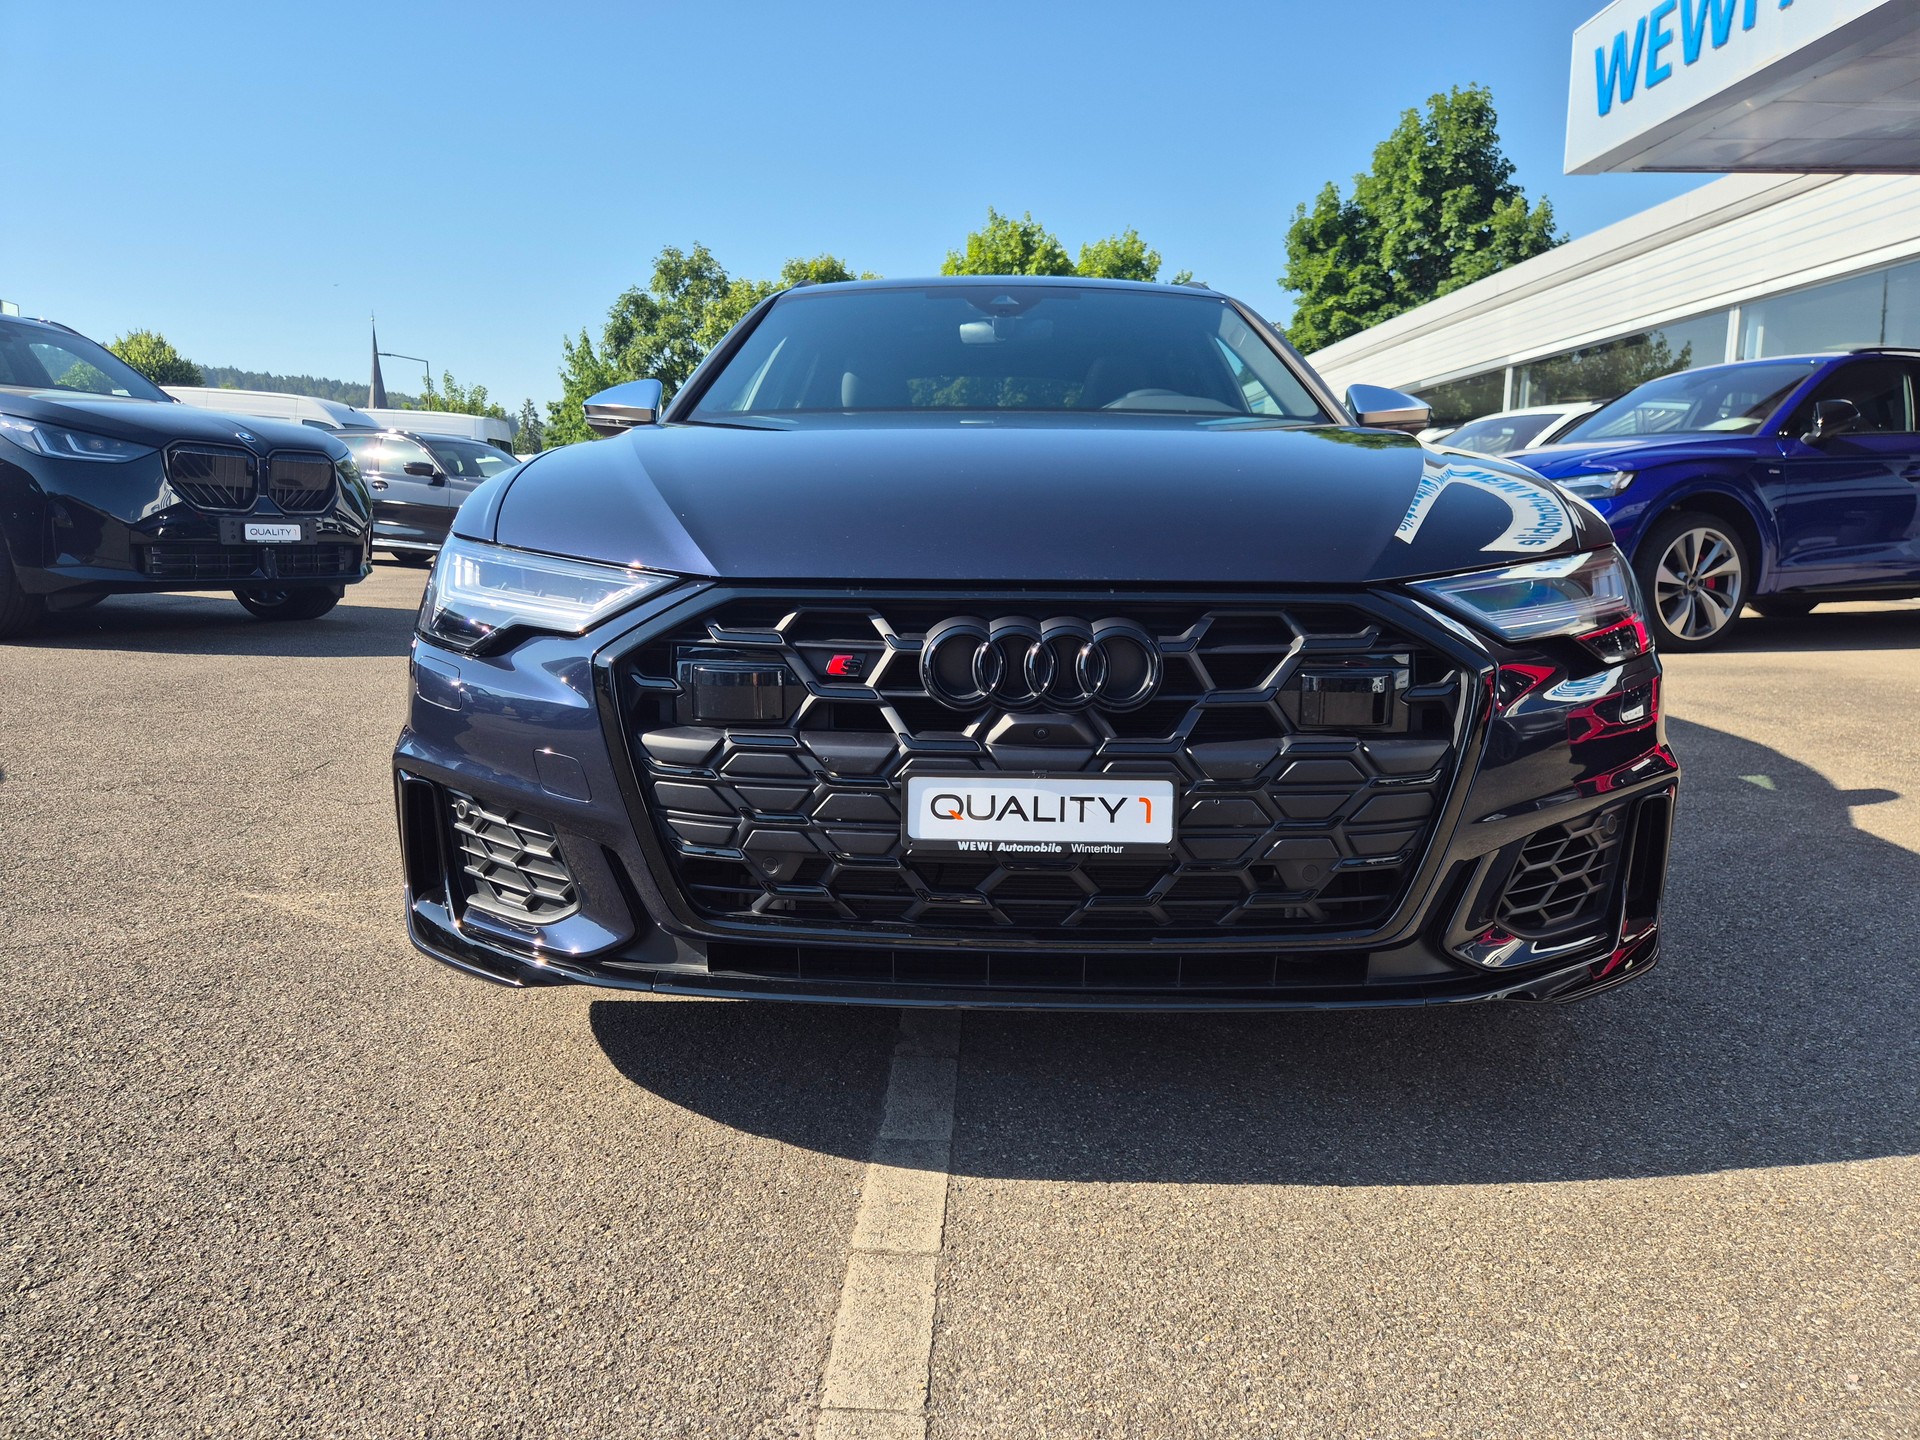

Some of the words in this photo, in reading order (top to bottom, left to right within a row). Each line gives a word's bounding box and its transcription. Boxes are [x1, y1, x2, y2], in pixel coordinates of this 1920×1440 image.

[250, 528, 292, 536] QUALITY
[930, 793, 1128, 824] QUALITY
[1138, 797, 1152, 824] 1
[957, 840, 993, 852] WEWi
[996, 841, 1063, 854] Automobile
[1071, 842, 1125, 855] Winterthur
